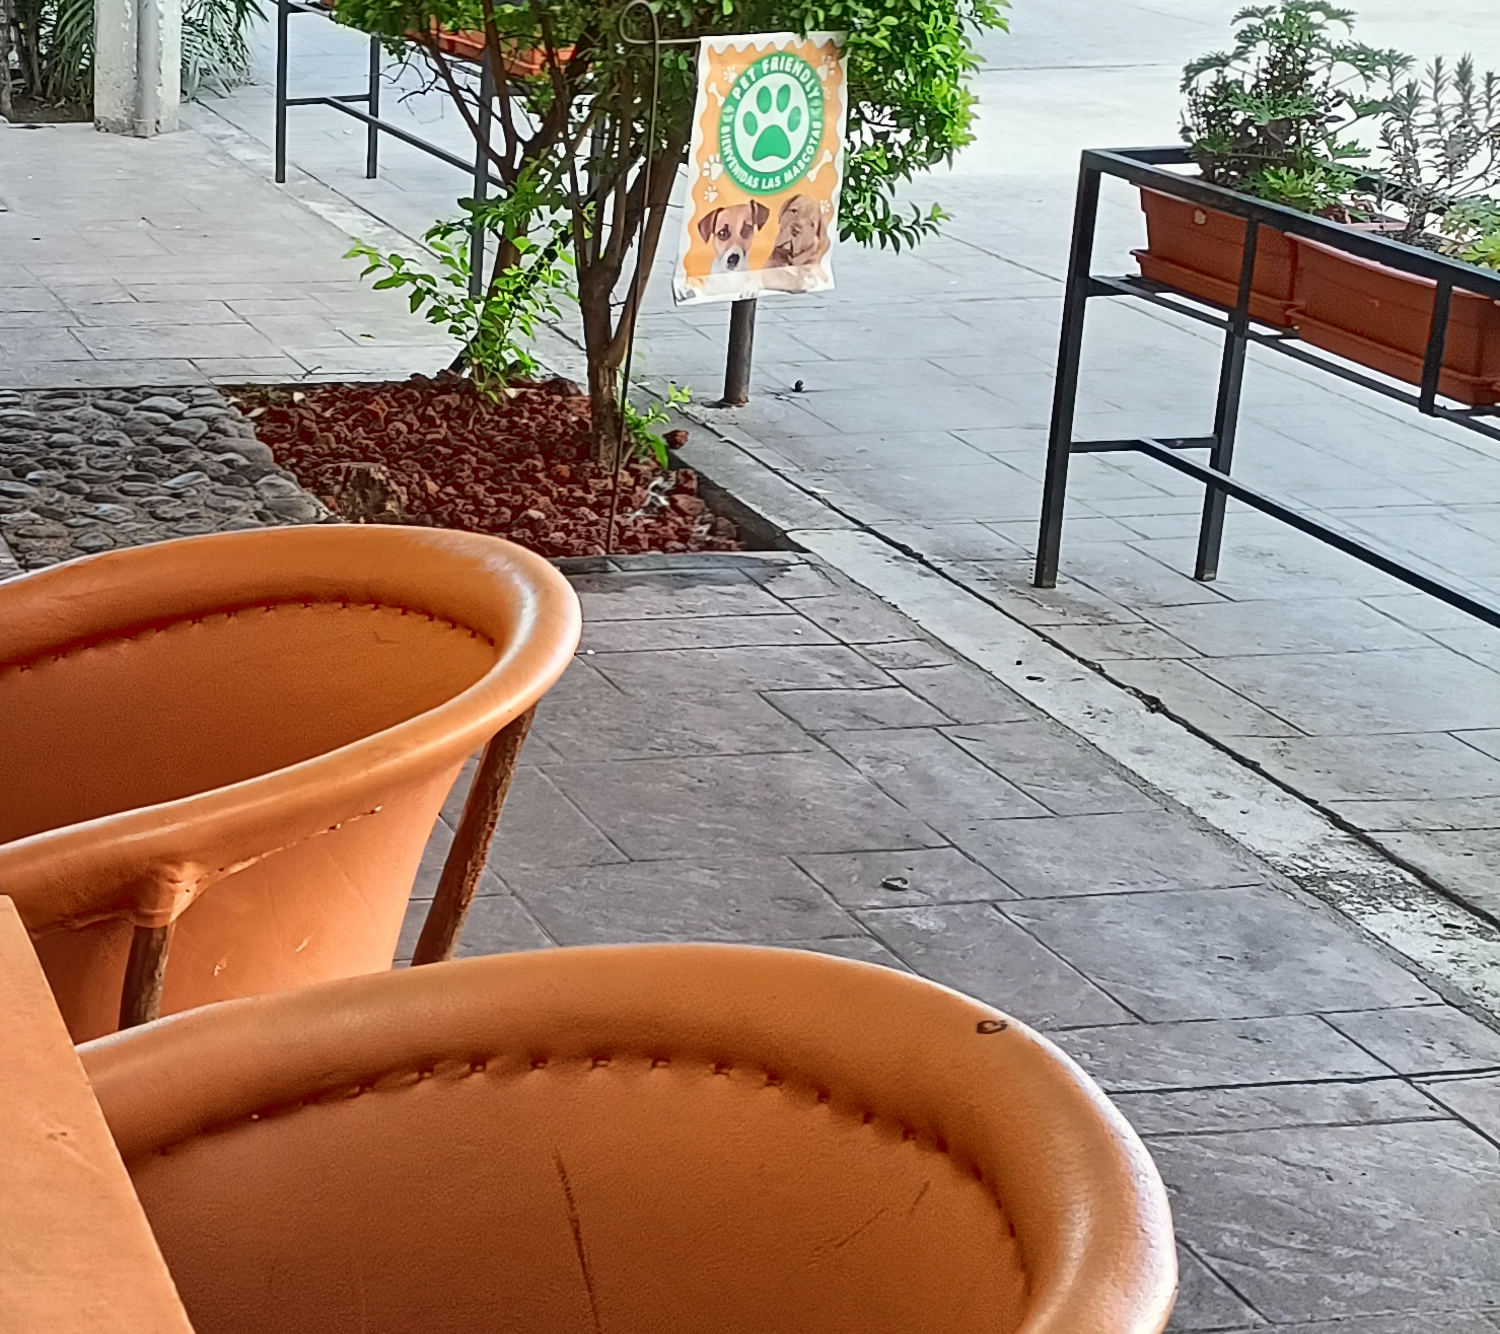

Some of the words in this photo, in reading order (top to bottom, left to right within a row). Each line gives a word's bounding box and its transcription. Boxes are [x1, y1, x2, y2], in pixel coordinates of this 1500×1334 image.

[731, 67, 756, 100] PET
[761, 55, 821, 99] FRIENDLY
[720, 125, 760, 189] BIENVENIDAS
[761, 175, 782, 190] LAS
[783, 120, 822, 183] MASCOTAS
